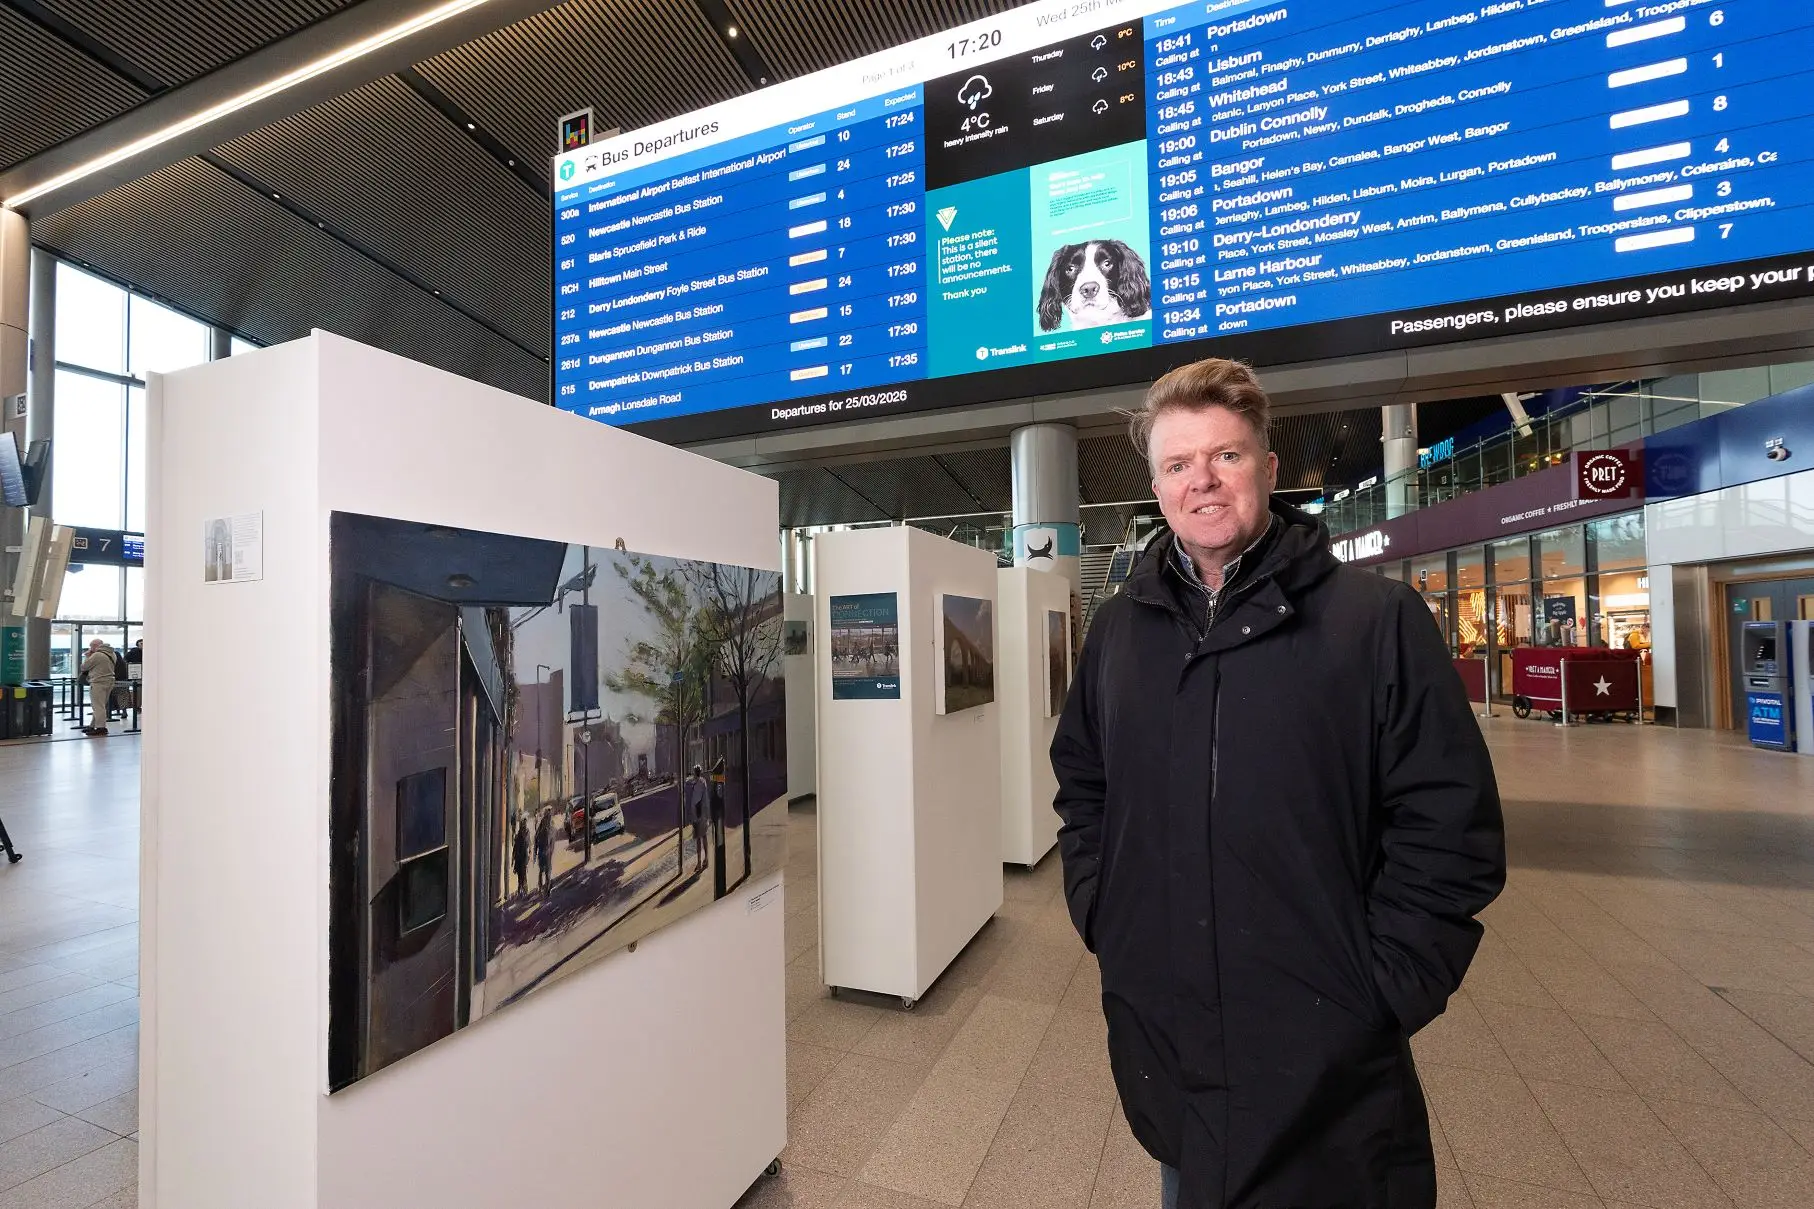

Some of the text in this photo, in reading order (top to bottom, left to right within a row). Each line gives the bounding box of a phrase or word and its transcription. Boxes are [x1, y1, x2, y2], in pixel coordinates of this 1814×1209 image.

[1036, 0, 1101, 27] Wed 25th
[1709, 9, 1724, 26] 6
[1207, 8, 1288, 40] Portadown
[947, 29, 1002, 59] 17:20
[1155, 33, 1191, 54] 18:41
[1211, 0, 1523, 87] Balmoral, Finaghy, Dunmurry, Derriaghy, Lambeg, Hilden,
[1031, 49, 1064, 64] Thursday
[1208, 51, 1263, 74] Lisburn
[1247, 97, 1285, 114] Lanyon
[1286, 90, 1319, 104] Place,
[1321, 81, 1348, 95] York
[1349, 72, 1387, 89] Street,
[1388, 55, 1461, 79] Whiteabbey,
[1463, 34, 1548, 61] Jordanstown,
[1550, 11, 1633, 40] Greenisland,
[861, 72, 886, 84] Page
[1156, 66, 1194, 87] 18:43
[884, 90, 917, 107] Expected
[1032, 83, 1055, 95] Friday
[1208, 77, 1288, 108] Whitehead
[885, 111, 915, 129] 17:24
[1033, 112, 1065, 126] Saturday
[1157, 100, 1195, 121] 18:45
[1242, 81, 1512, 150] Portadown, Newry, Dundalk, Drogheda, Connolly
[960, 112, 990, 132] 4°C
[1210, 105, 1328, 143] Dublin Connolly
[602, 121, 719, 167] Bus Departures
[837, 129, 850, 142] 10
[943, 125, 1009, 148] heavy intensity rain
[1158, 135, 1196, 154] 19:00
[885, 141, 915, 158] 17:25
[1222, 121, 1510, 189] Seahill, Helen's Bay, Carnalea, Bangor West, Bangor
[1211, 156, 1265, 178] Bangor
[588, 189, 640, 213] International
[640, 181, 671, 198] Airport
[671, 173, 701, 190] Belfast
[701, 156, 755, 181] International
[1159, 169, 1197, 188] 19:05
[1400, 166, 1485, 190] Moira, Lurgan,
[1314, 157, 1755, 243] Mossley West, Antrim, Ballymena, Cullybackey, Ballymoney, Coleraine,
[560, 208, 580, 221] 300a
[588, 195, 723, 238] Newcastle Newcastle Bus Station
[1160, 203, 1198, 222] 19:06
[1577, 197, 1776, 237] Trooperslane, Clipperstown,
[941, 229, 995, 246] Please note:
[1213, 210, 1361, 247] Derry~Londonderry
[1718, 223, 1734, 239] 7
[560, 233, 576, 246] 520
[588, 225, 707, 264] Blaris Sprucefield Park & Ride
[941, 245, 958, 255] This
[959, 243, 966, 252] is
[974, 237, 998, 249] silent
[1161, 238, 1199, 257] 19:10
[942, 248, 998, 265] station, there
[588, 261, 668, 289] Hilltown Main Street
[941, 261, 981, 274] will be no
[942, 264, 1013, 284] announcements.
[1214, 254, 1323, 283] Larne Harbour
[561, 282, 579, 295] RCH
[588, 266, 769, 314] Derry Londonderry Foyle Street Bus Station
[1162, 273, 1200, 291] 19:15
[942, 287, 987, 301] Thank you
[1391, 266, 1803, 335] Passengers, please ensure you keep your
[560, 308, 576, 321] 212
[1163, 307, 1201, 325] 19:34
[560, 333, 581, 346] 237a
[989, 343, 1027, 357] Translink
[588, 355, 744, 391] Downpatrick Downpatrick Bus Station
[560, 384, 576, 396] 515
[586, 402, 621, 421] Armagh
[621, 396, 658, 411] Lonsdale
[659, 392, 682, 405] Road
[771, 389, 908, 420] Departures for 25/03/2026
[1584, 454, 1624, 469] ORGANIC COFFEE
[1592, 466, 1617, 482] PRET
[1501, 512, 1525, 525] ORGANIC
[1525, 507, 1546, 519] COFFEE
[1553, 499, 1578, 513] FRESHLY
[99, 538, 111, 552] 7
[1752, 706, 1781, 719] ATM
